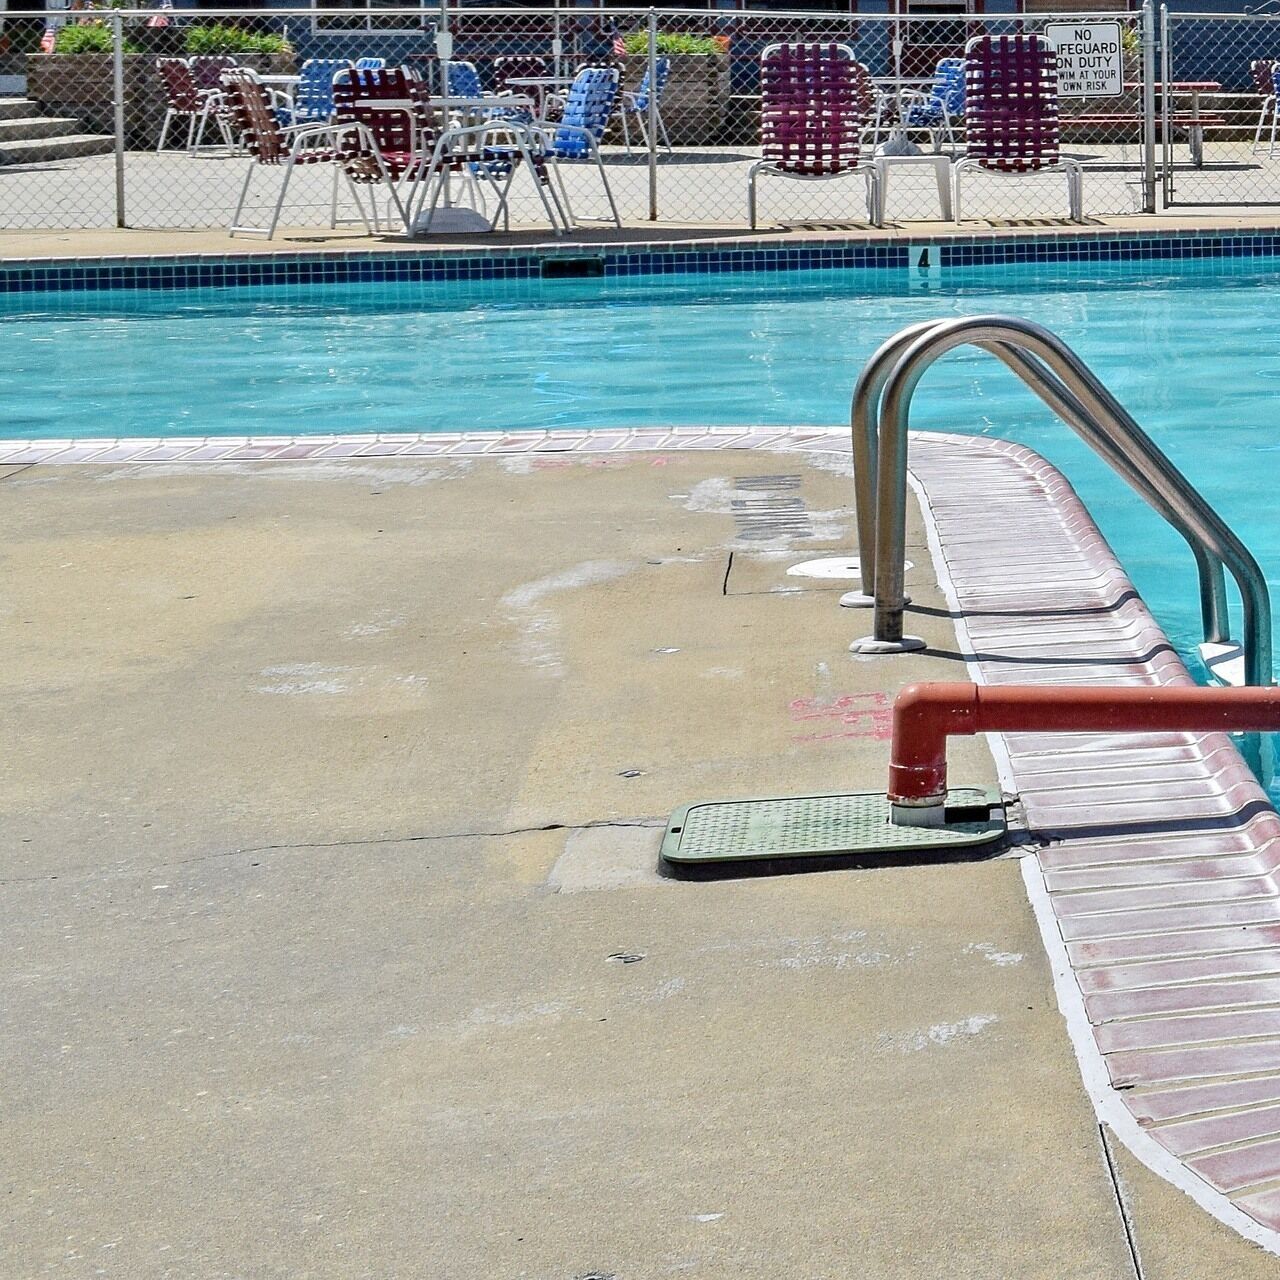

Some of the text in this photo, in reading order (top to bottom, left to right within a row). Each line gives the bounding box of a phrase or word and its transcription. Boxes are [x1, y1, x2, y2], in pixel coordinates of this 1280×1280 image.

[1074, 29, 1092, 41] NO
[1057, 42, 1118, 55] IFEGUARD
[1056, 56, 1113, 68] ON DUTY
[1056, 69, 1117, 80] WIM AT YOUR
[1063, 81, 1107, 92] OWN RISK
[918, 248, 930, 267] 4
